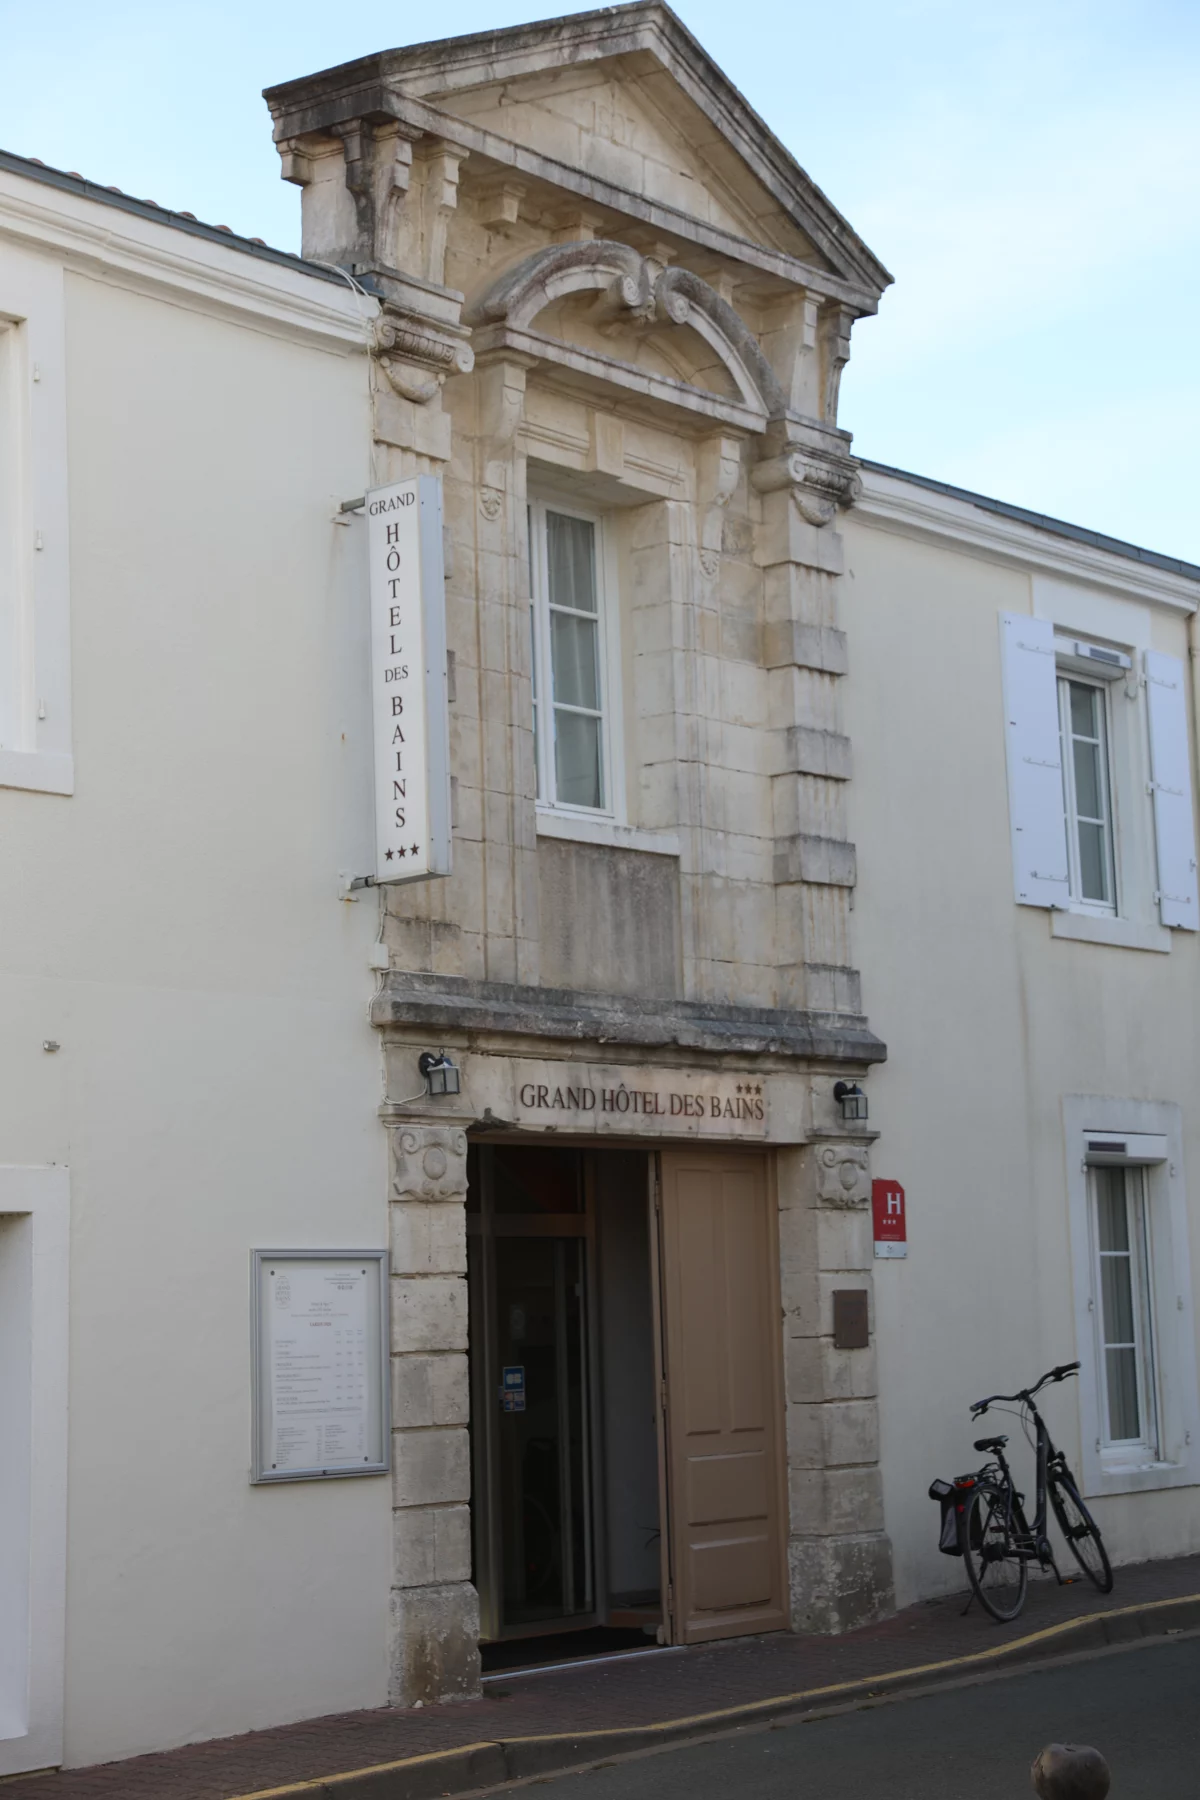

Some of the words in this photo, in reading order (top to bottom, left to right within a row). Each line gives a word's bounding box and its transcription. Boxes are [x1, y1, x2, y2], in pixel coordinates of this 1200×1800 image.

[369, 491, 415, 517] GRAND
[386, 522, 402, 655] HÔTEL
[384, 665, 409, 683] DES
[391, 695, 407, 828] BAINS
[520, 1083, 597, 1111] GRAND
[601, 1083, 666, 1116] HÔTEL
[670, 1093, 705, 1117] DES
[710, 1095, 765, 1121] BAINS
[885, 1192, 902, 1215] H
